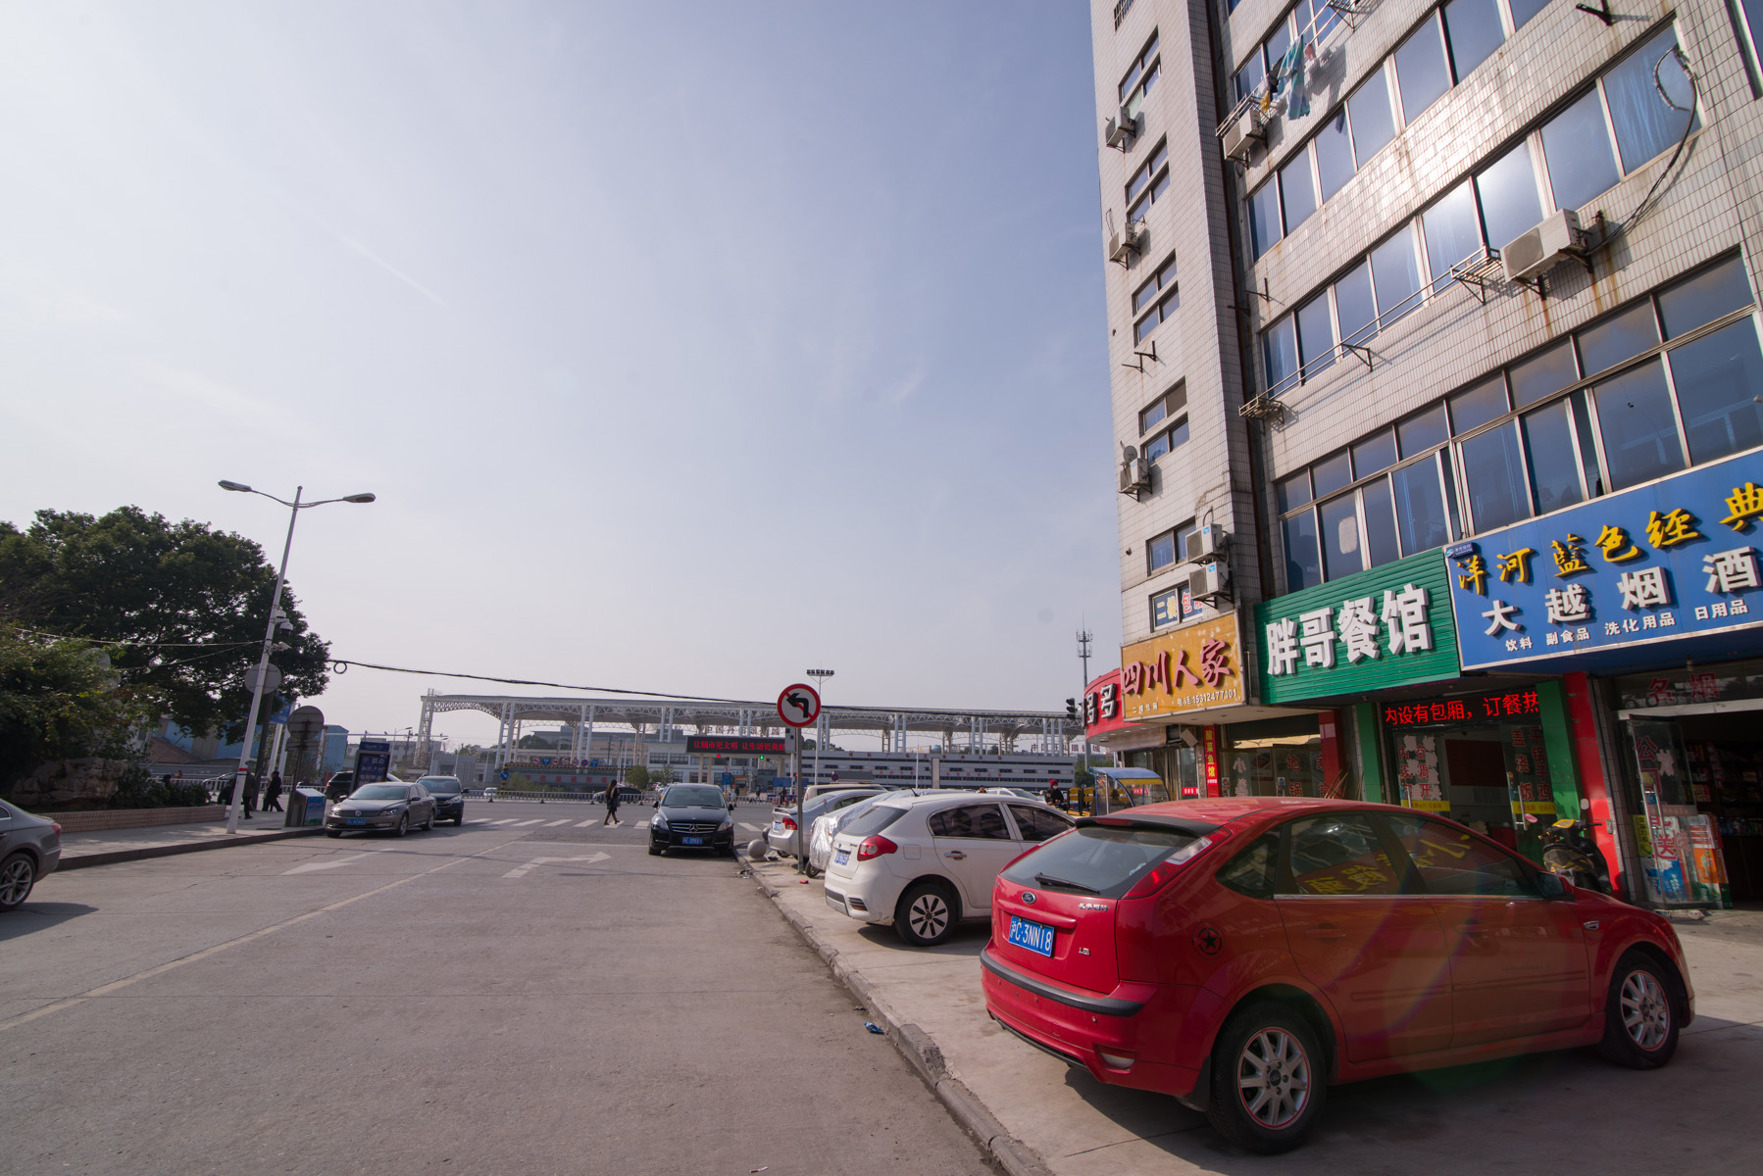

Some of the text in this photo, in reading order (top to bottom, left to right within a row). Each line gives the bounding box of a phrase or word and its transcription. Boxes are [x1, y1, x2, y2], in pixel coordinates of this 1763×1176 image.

[1482, 547, 1760, 637] 大越烟酒
[1505, 599, 1750, 652] 饮料 副食品 洗化用品 日用品
[1265, 583, 1433, 676] 胖哥餐馆
[1121, 639, 1231, 695] 四川人家
